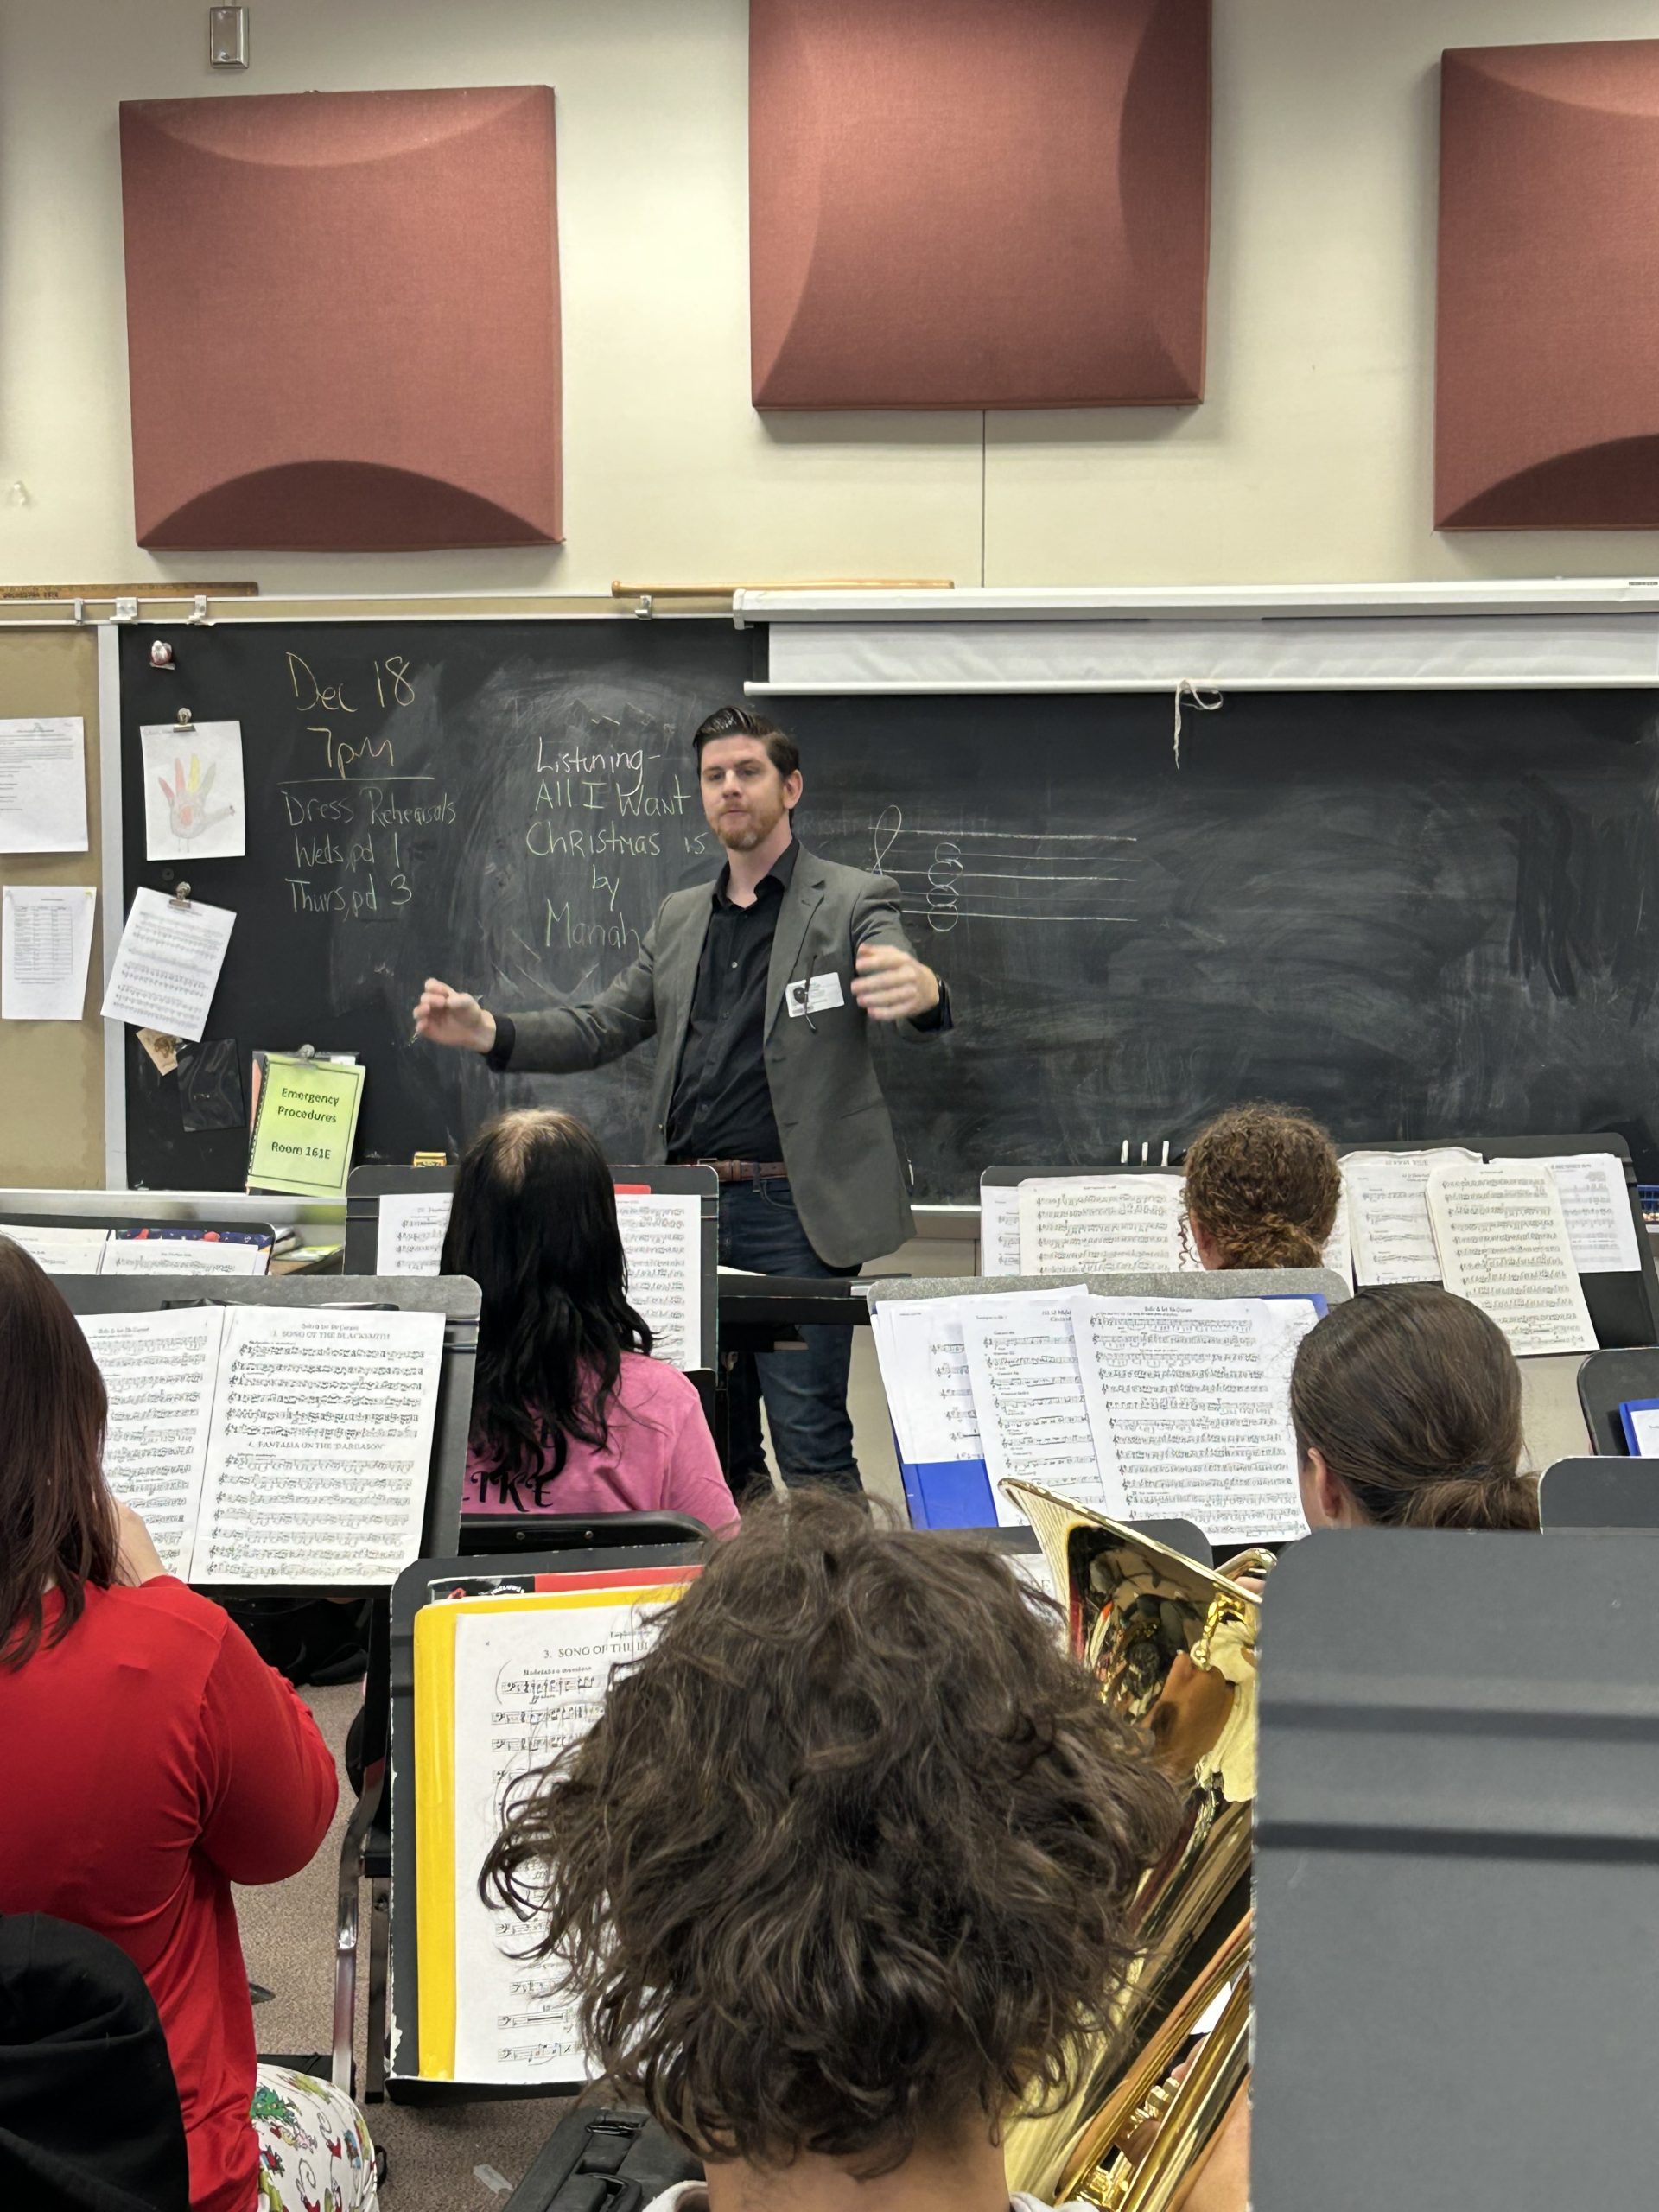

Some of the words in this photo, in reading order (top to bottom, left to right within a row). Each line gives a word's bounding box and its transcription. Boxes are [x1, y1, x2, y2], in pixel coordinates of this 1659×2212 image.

[285, 652, 358, 712] Dec
[374, 656, 415, 708] 18
[281, 791, 354, 826] Dress
[535, 779, 572, 811] All
[582, 781, 607, 809] I
[616, 774, 691, 816] Want
[394, 832, 400, 868] 1
[684, 832, 709, 855] is
[391, 874, 412, 905] 3
[592, 864, 620, 912] by
[282, 1088, 340, 1107] Emergency
[277, 1106, 337, 1123] Procedures
[271, 1141, 302, 1155] Room
[305, 1147, 332, 1160] 161E
[558, 1646, 591, 1658] SONG
